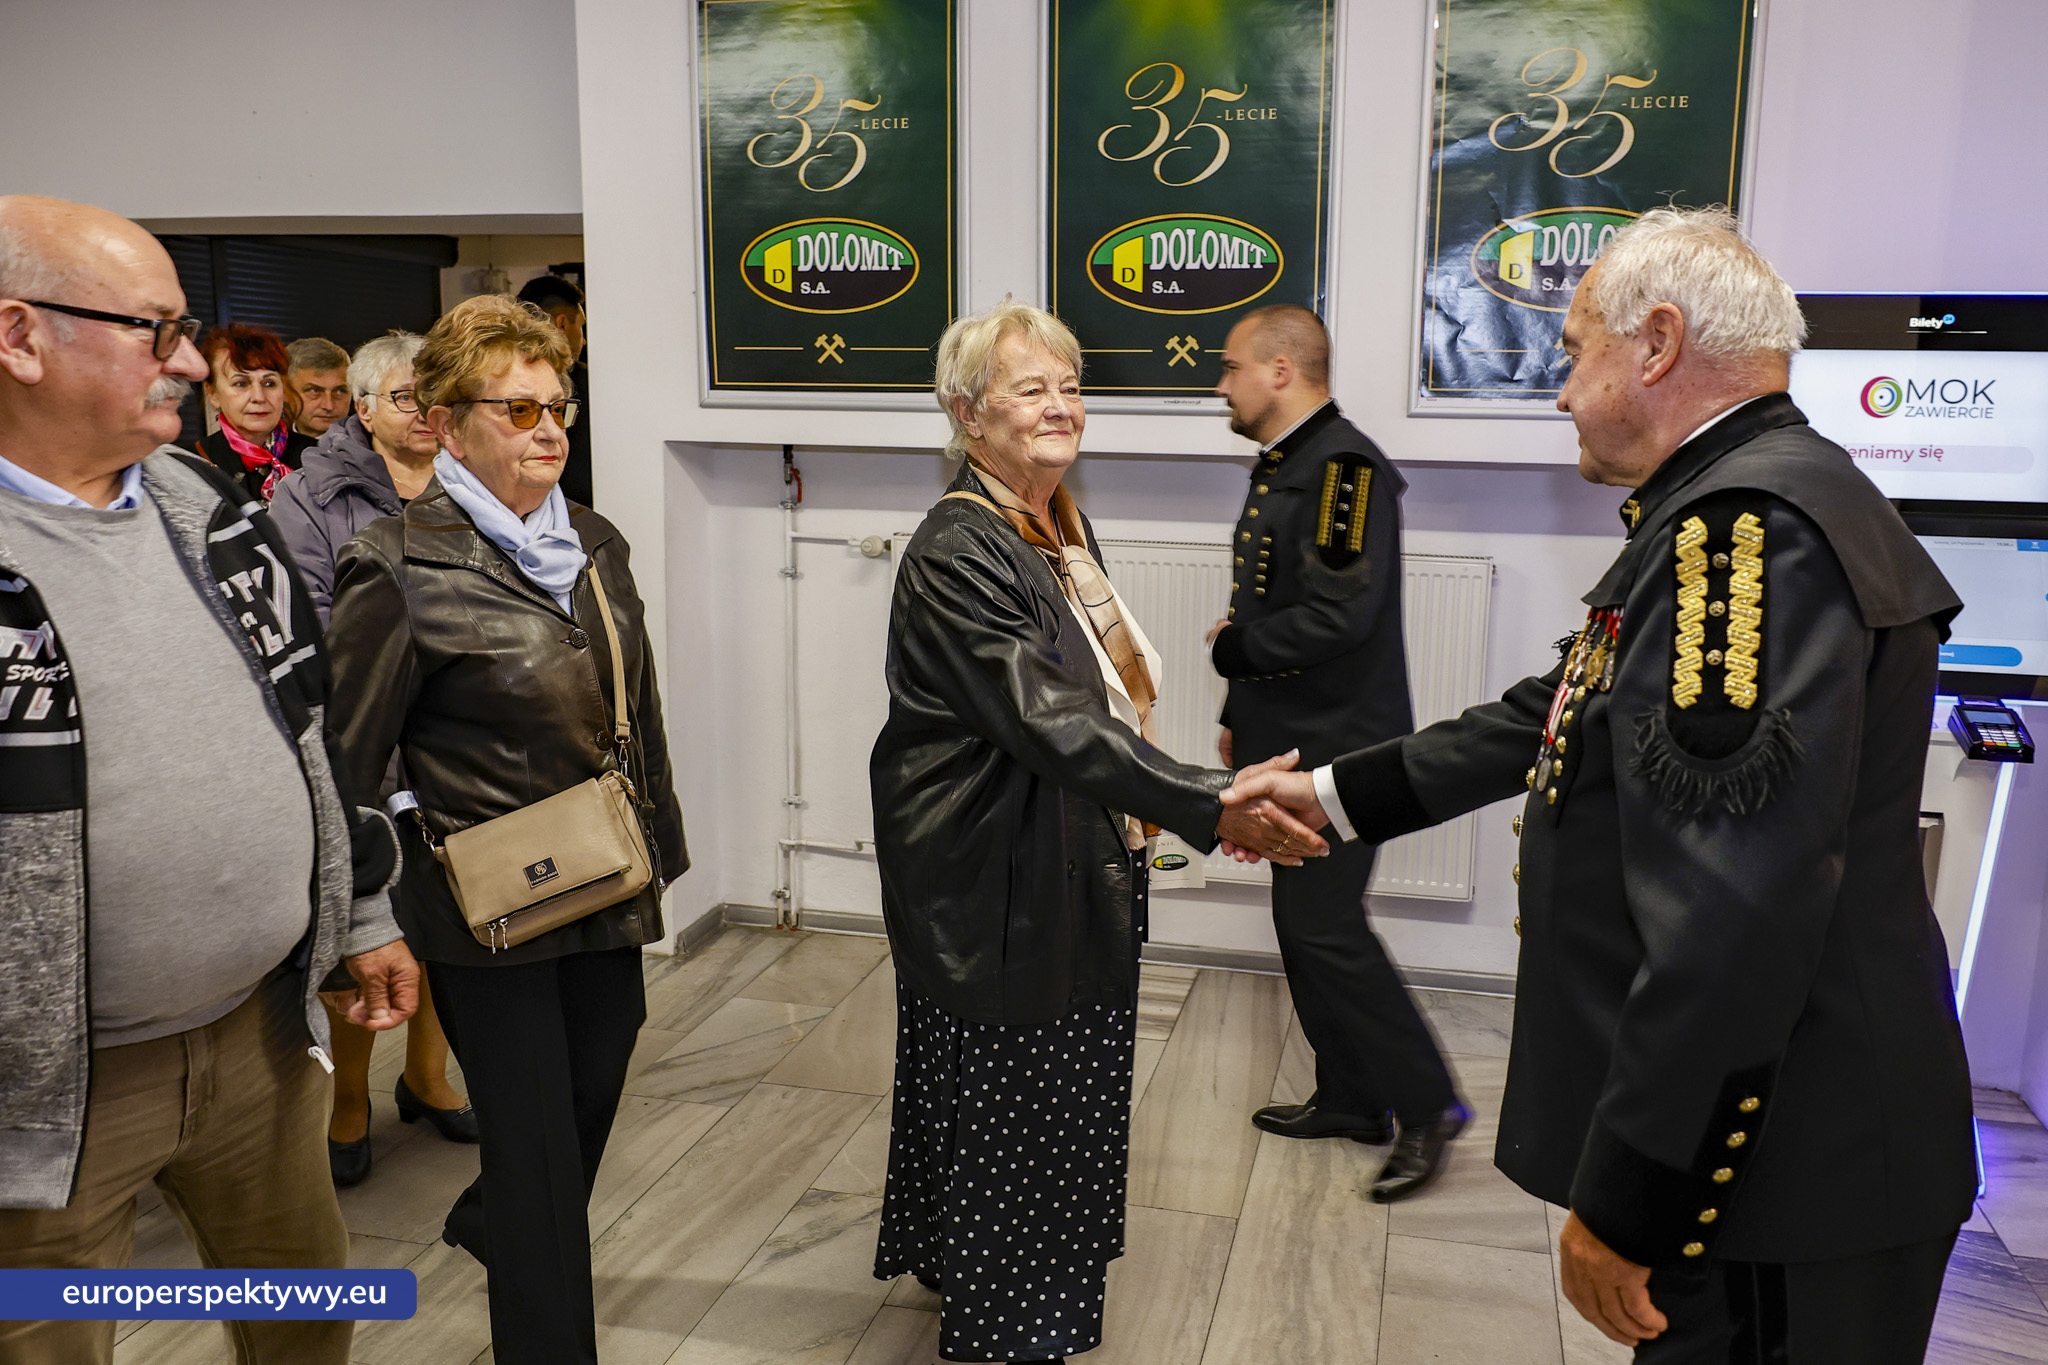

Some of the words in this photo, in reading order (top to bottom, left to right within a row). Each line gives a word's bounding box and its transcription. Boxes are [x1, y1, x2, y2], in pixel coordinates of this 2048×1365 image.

[1488, 47, 1657, 178] 35
[747, 74, 881, 192] 35
[1097, 62, 1248, 187] 35
[797, 231, 905, 273] DOLOMIT
[1149, 228, 1267, 271] DOLOMIT
[1540, 222, 1617, 267] DOLO
[772, 269, 786, 284] D
[1122, 267, 1136, 283] D
[1508, 263, 1524, 280] D
[800, 281, 831, 295] S.A.
[1152, 280, 1185, 294] S.A.
[1906, 379, 1996, 405] MOK
[1905, 405, 1994, 419] ZAWIERCIE
[1843, 444, 1915, 463] eniamy
[1919, 444, 1944, 463] się
